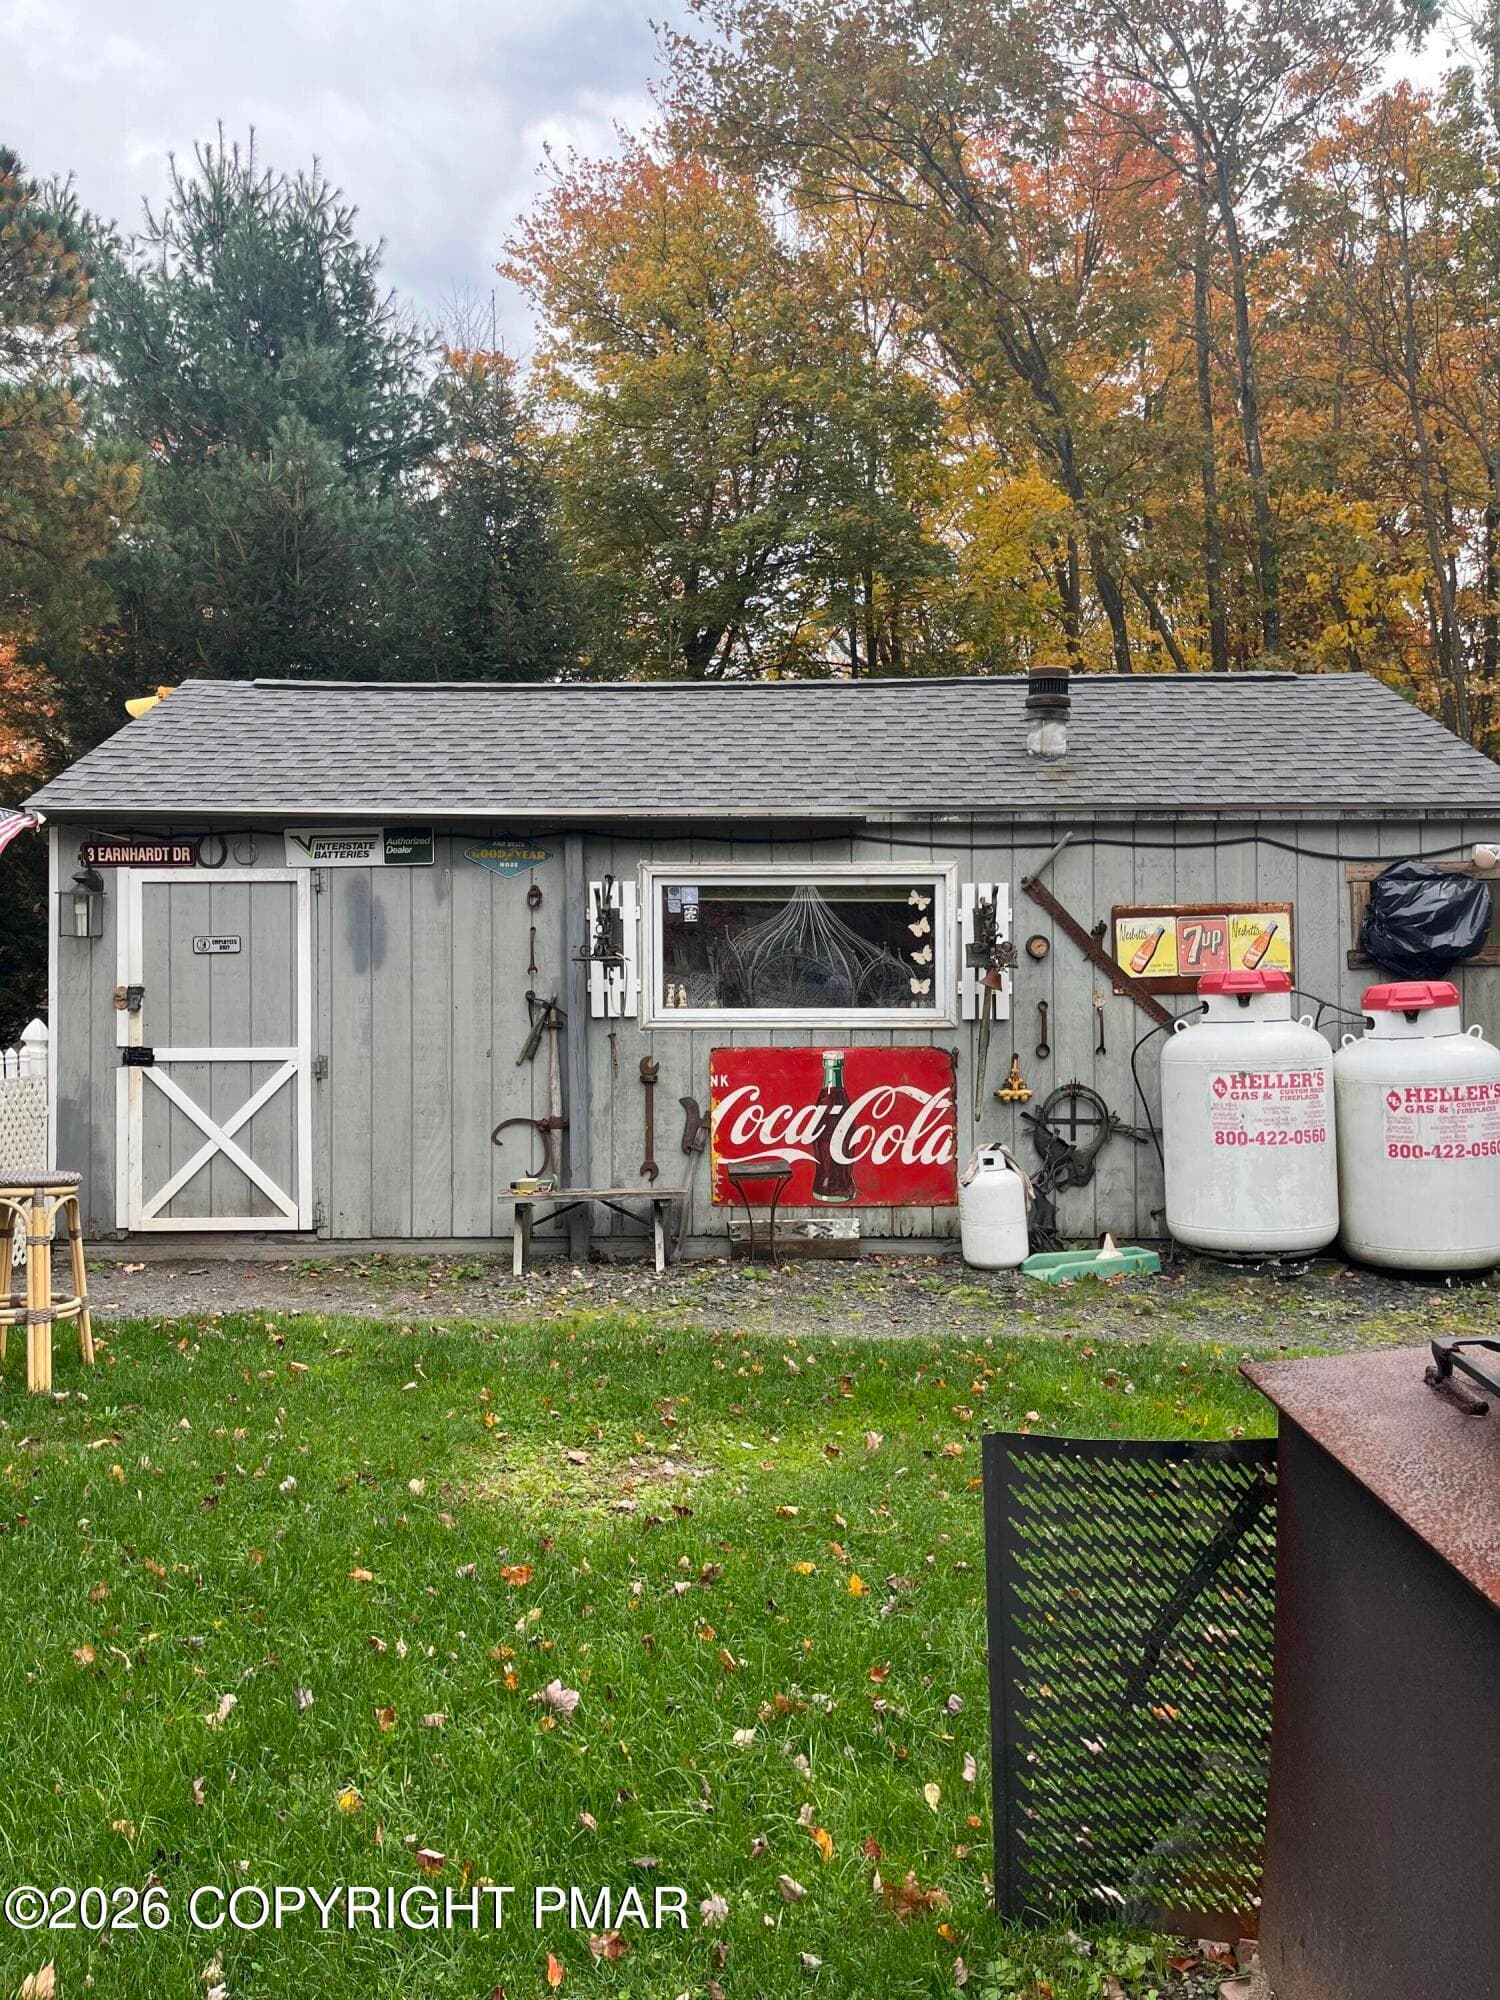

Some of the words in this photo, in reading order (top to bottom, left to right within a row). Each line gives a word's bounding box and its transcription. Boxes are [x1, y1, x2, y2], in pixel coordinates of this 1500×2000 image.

[386, 837, 430, 845] Authorized
[315, 842, 376, 850] INTERSTATE
[386, 846, 413, 854] Dealer
[87, 847, 95, 861] 3
[98, 847, 170, 861] EARNHARDT
[173, 847, 191, 861] DR
[314, 850, 370, 859] BATTERIES
[1230, 1072, 1325, 1089] HELLER'S
[1230, 1091, 1258, 1100] GAS
[1263, 1091, 1273, 1100] &
[1405, 1104, 1434, 1113] GAS
[1438, 1104, 1449, 1113] &
[1215, 1128, 1326, 1146] 800-422-0560
